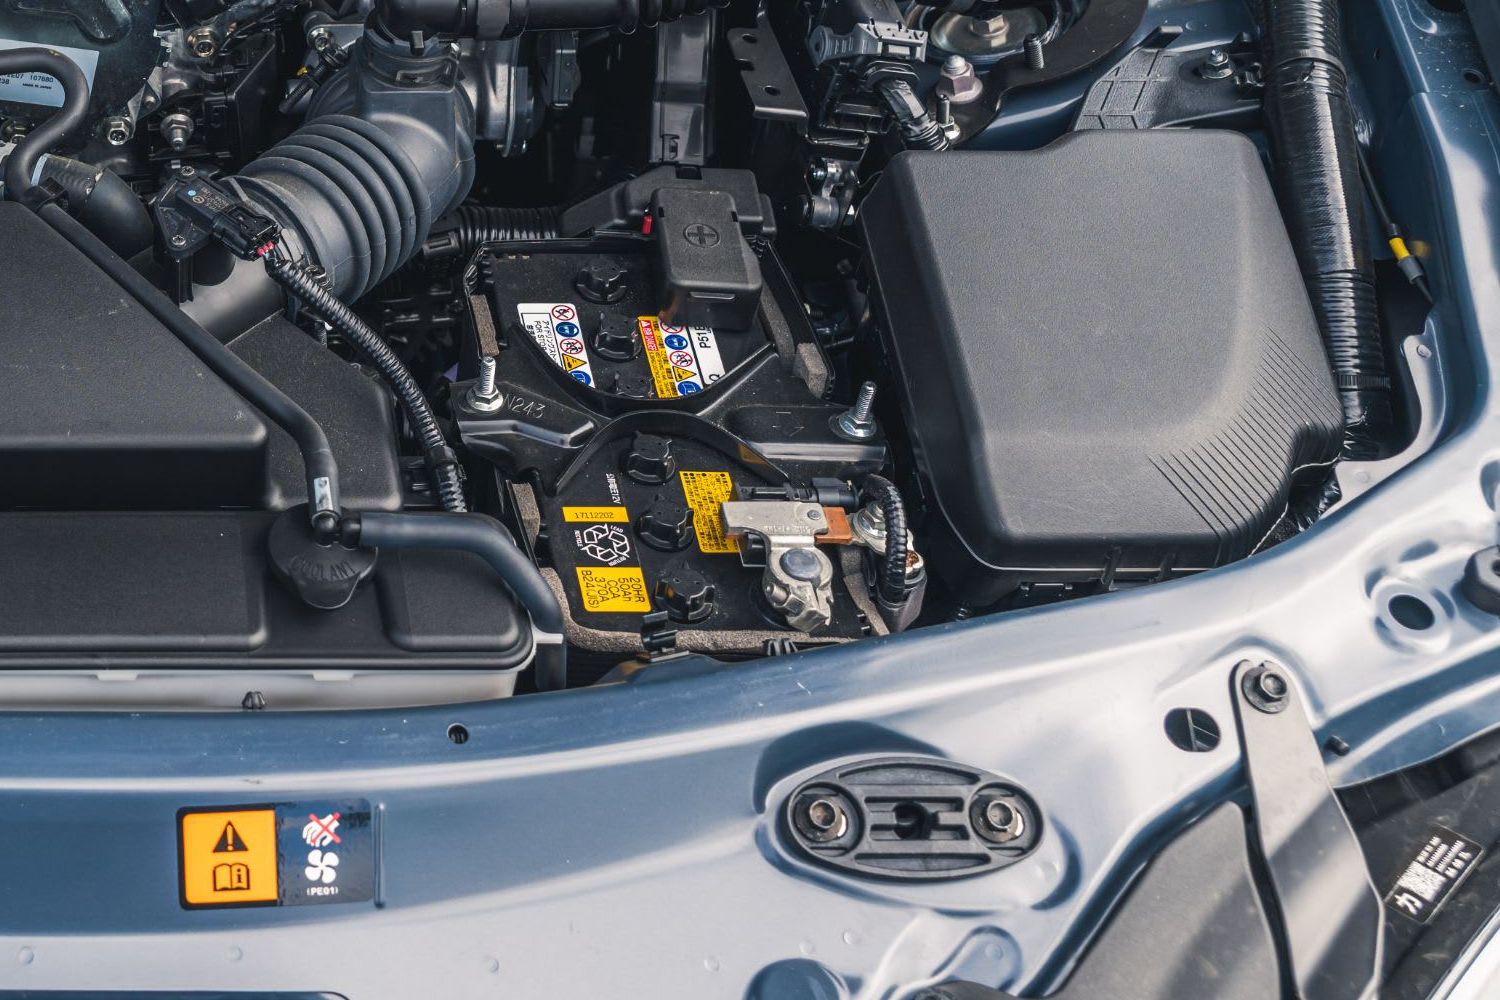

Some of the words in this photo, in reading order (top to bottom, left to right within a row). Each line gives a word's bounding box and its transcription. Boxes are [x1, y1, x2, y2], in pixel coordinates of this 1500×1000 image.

[534, 321, 543, 333] FOR
[504, 394, 546, 418] N243
[610, 525, 624, 533] LEAD
[595, 577, 610, 602] 370A
[606, 579, 621, 599] CCA
[618, 577, 633, 602] 50Ah
[629, 577, 645, 603] 20HR
[307, 886, 339, 896] (PE01)
